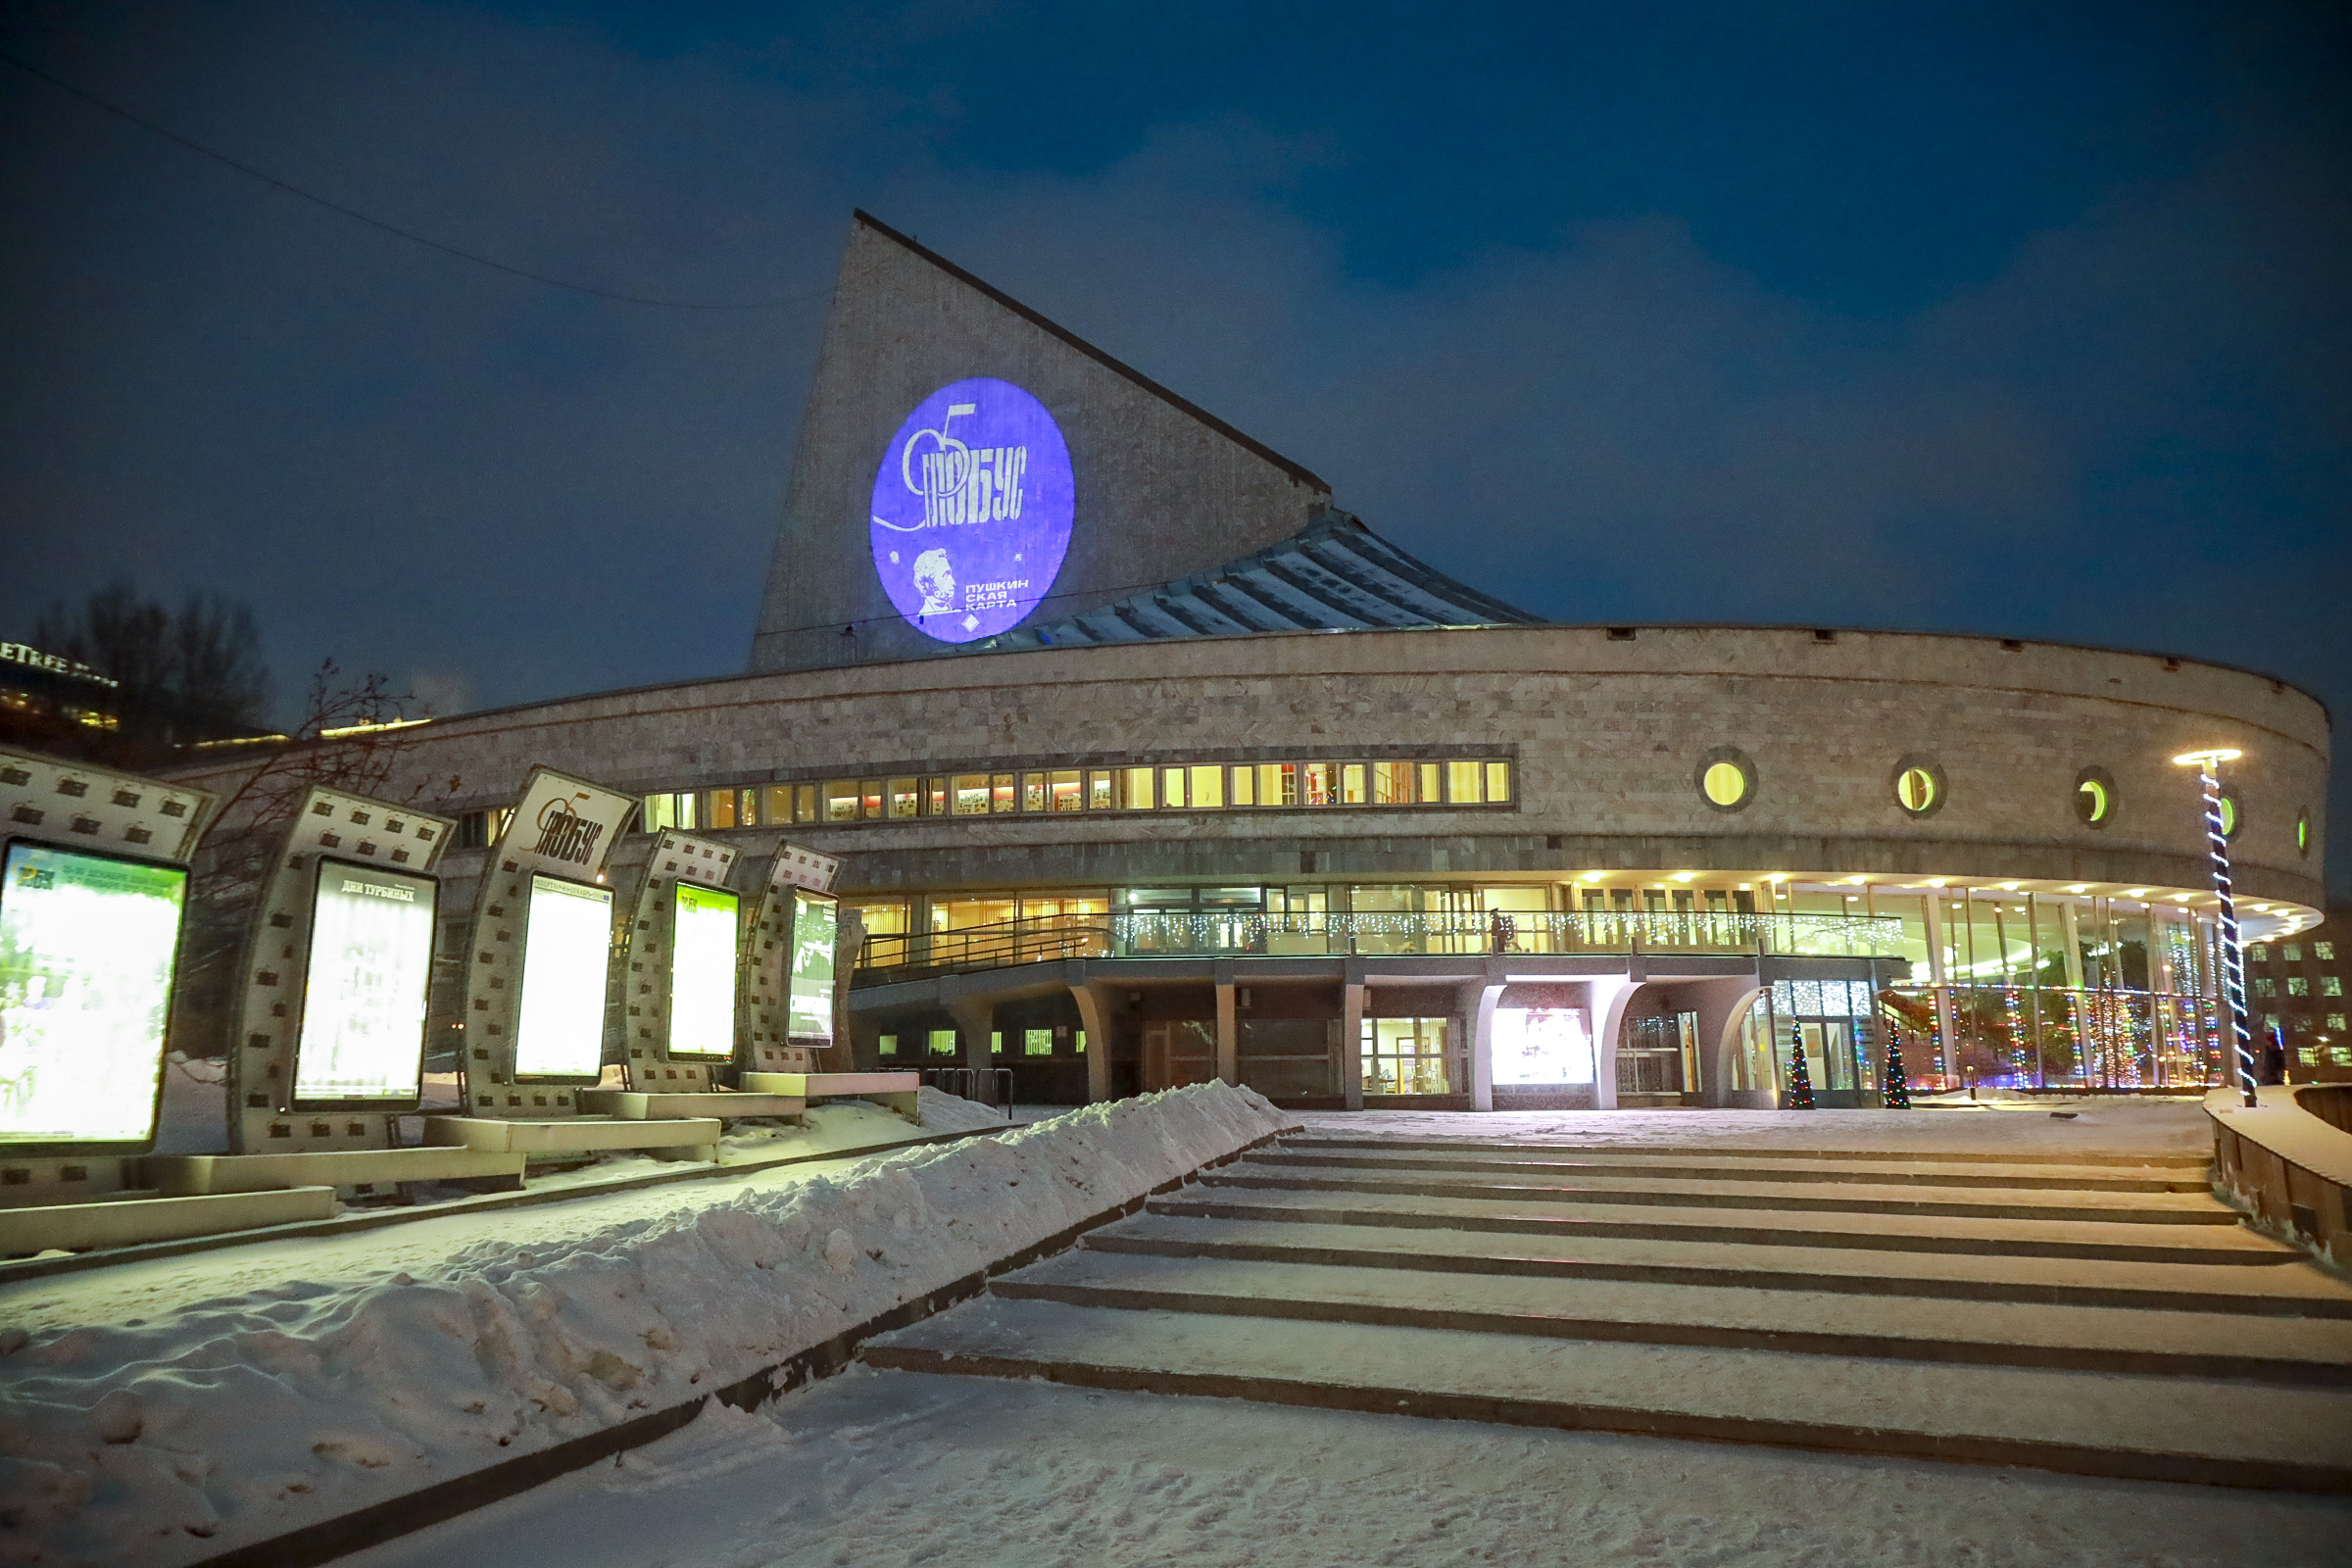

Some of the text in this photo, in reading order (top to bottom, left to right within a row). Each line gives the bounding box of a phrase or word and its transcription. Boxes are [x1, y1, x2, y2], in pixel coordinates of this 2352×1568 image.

[922, 445, 1028, 528] ГЛОБУС
[965, 579, 1029, 594] ПУШКИН
[965, 591, 1007, 603] СКАЯ
[965, 599, 1017, 612] КАРТА
[534, 810, 604, 866] ГЛОБУС
[341, 880, 364, 894] ДНИ
[365, 884, 415, 902] ТУРБИНЫХ
